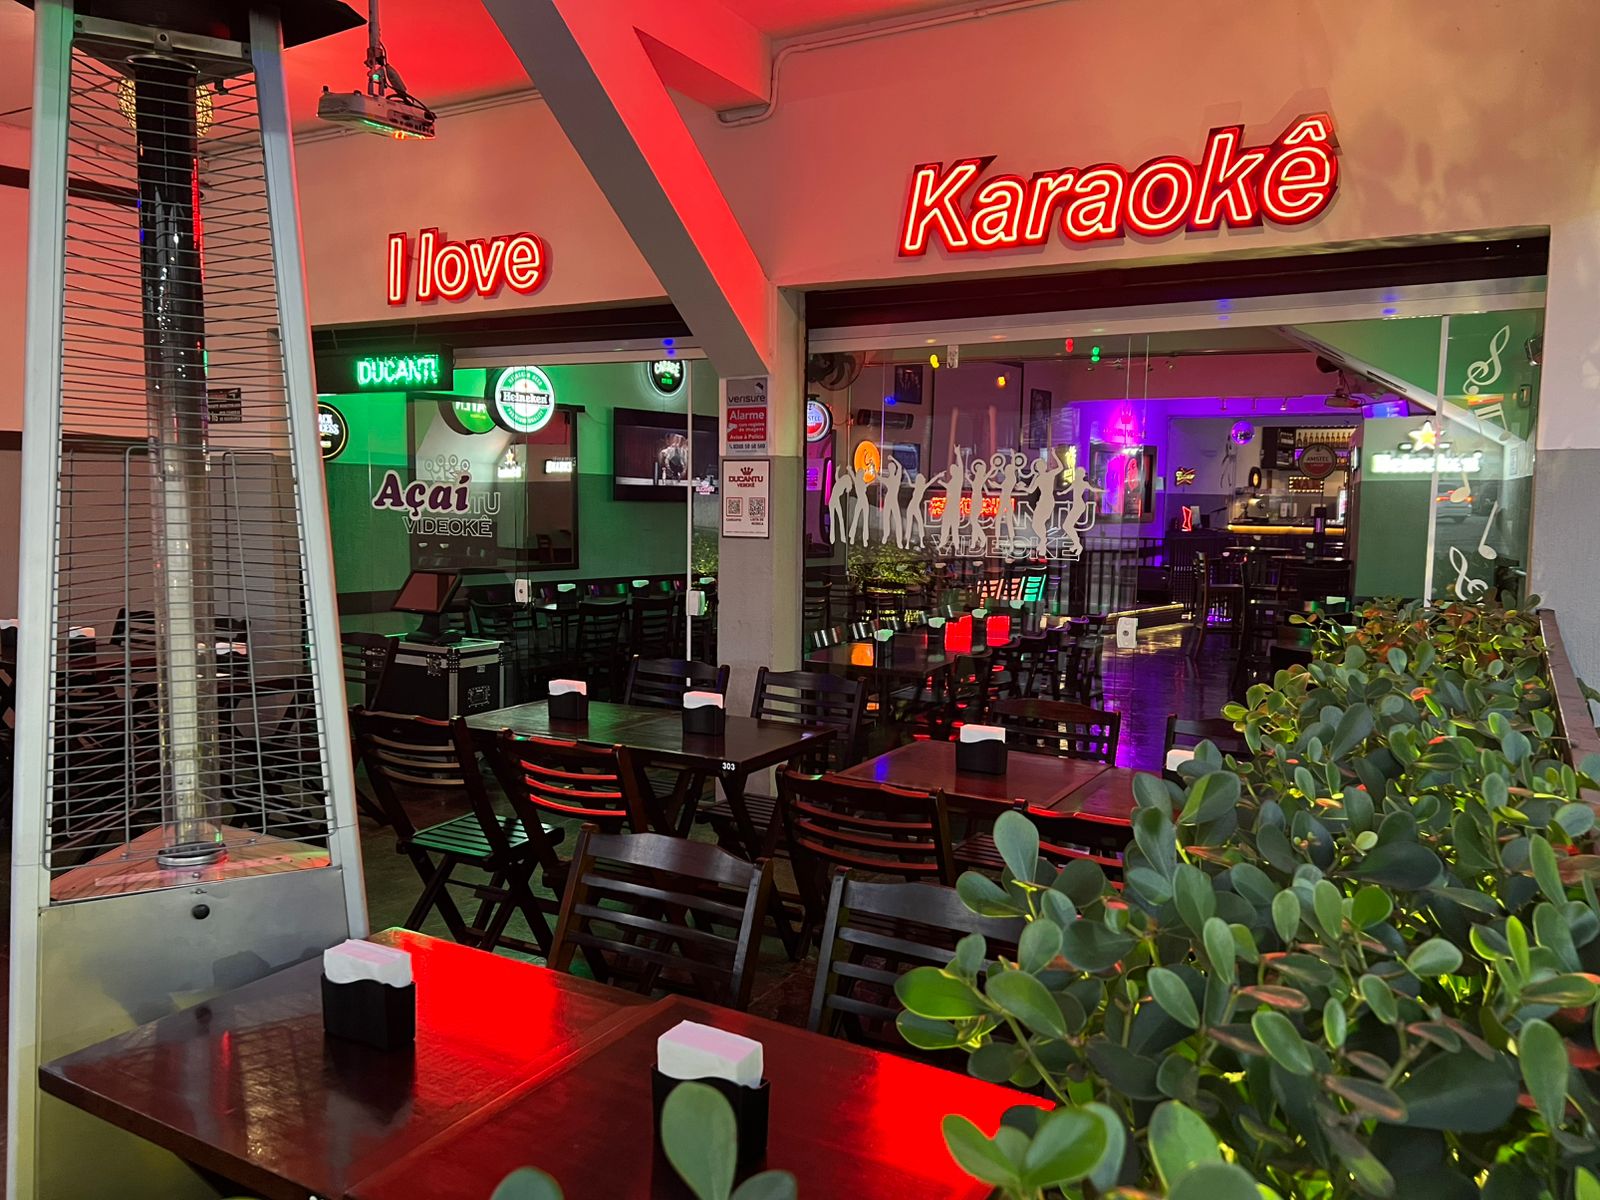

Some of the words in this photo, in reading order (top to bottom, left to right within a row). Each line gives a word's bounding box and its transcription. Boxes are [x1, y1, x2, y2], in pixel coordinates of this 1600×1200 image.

[898, 112, 1339, 257] Karaokê
[387, 232, 408, 305] I
[416, 227, 546, 302] love
[502, 391, 549, 405] Heineken
[728, 394, 766, 403] verisure
[729, 410, 765, 420] Alarme
[402, 515, 493, 538] VIDEOKÊ
[722, 761, 736, 771] 303
